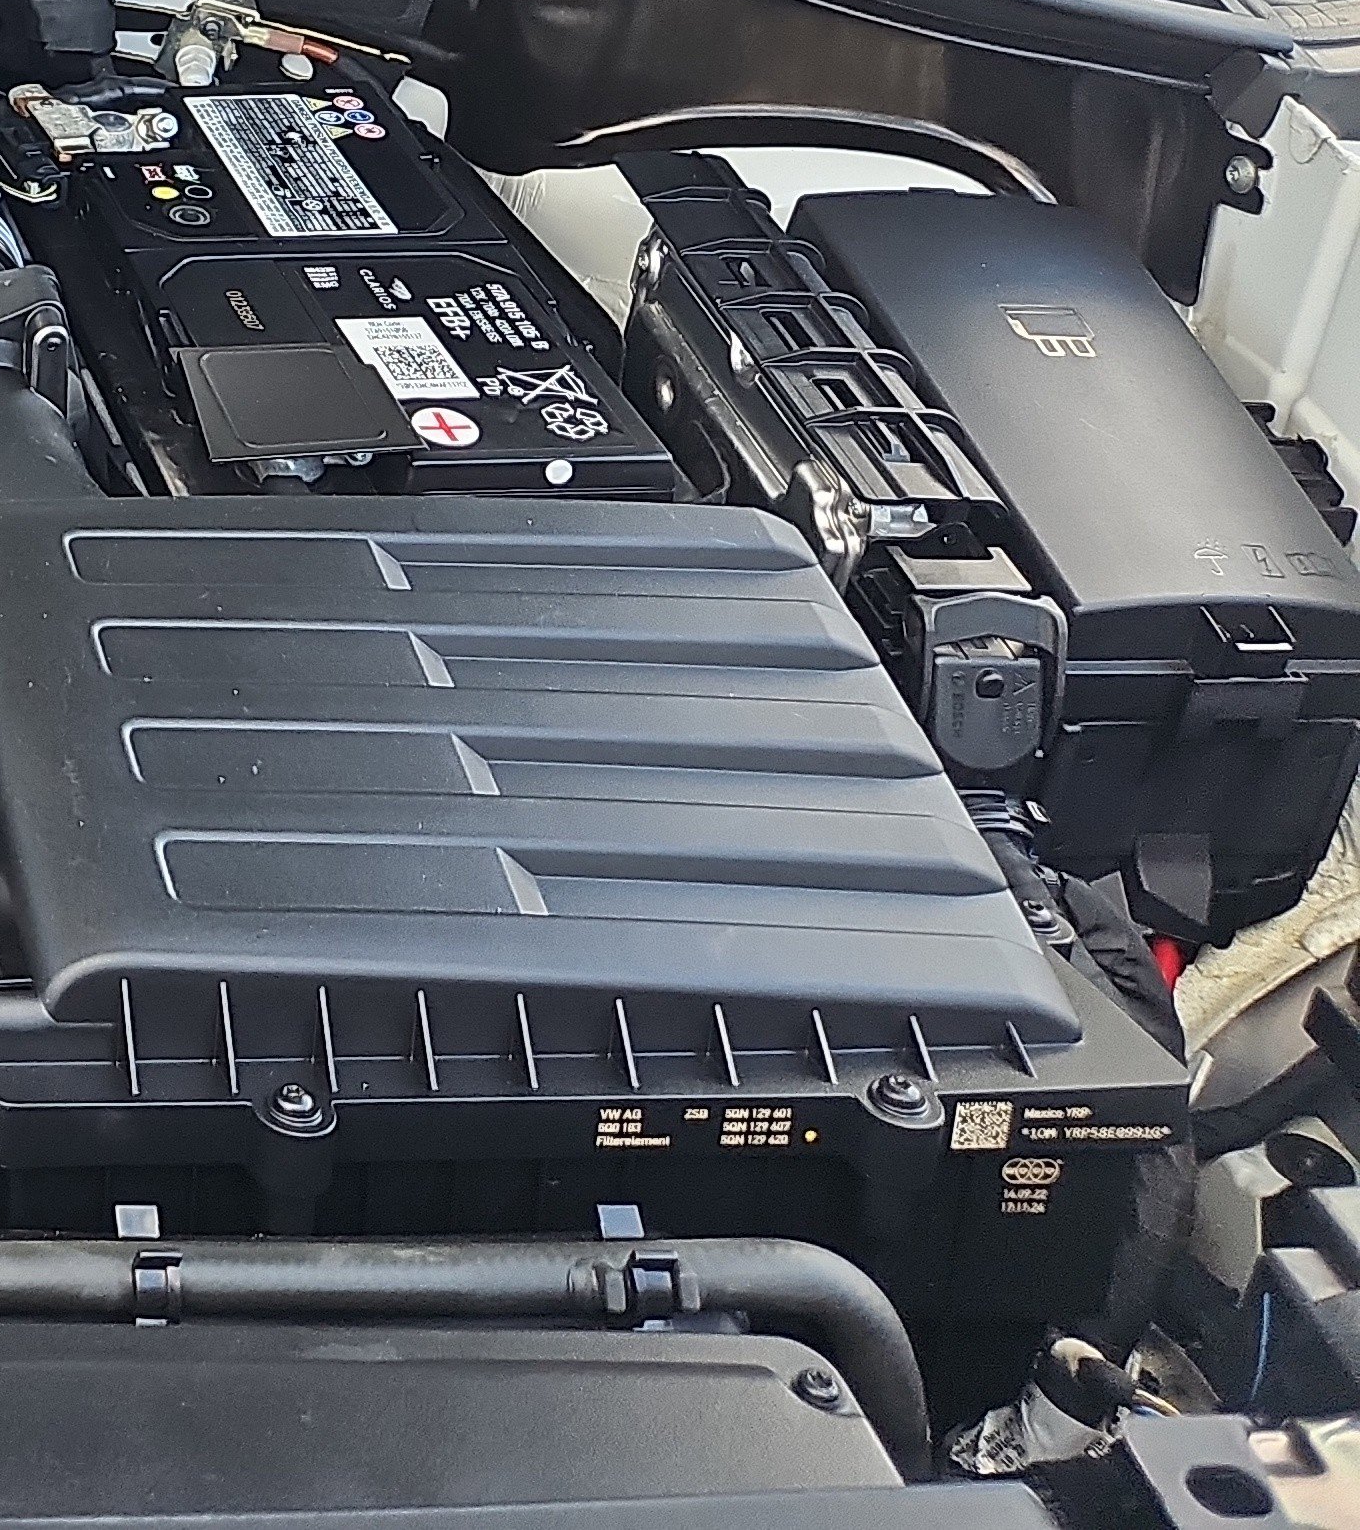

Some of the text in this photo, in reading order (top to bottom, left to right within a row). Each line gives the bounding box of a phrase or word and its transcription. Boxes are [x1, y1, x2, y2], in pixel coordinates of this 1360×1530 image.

[359, 268, 397, 310] CLARIOS
[425, 297, 471, 341] EFB+
[475, 376, 504, 396] Pb
[599, 1108, 622, 1120] VW
[752, 1107, 771, 1119] 129
[1023, 1107, 1066, 1119] Mexico
